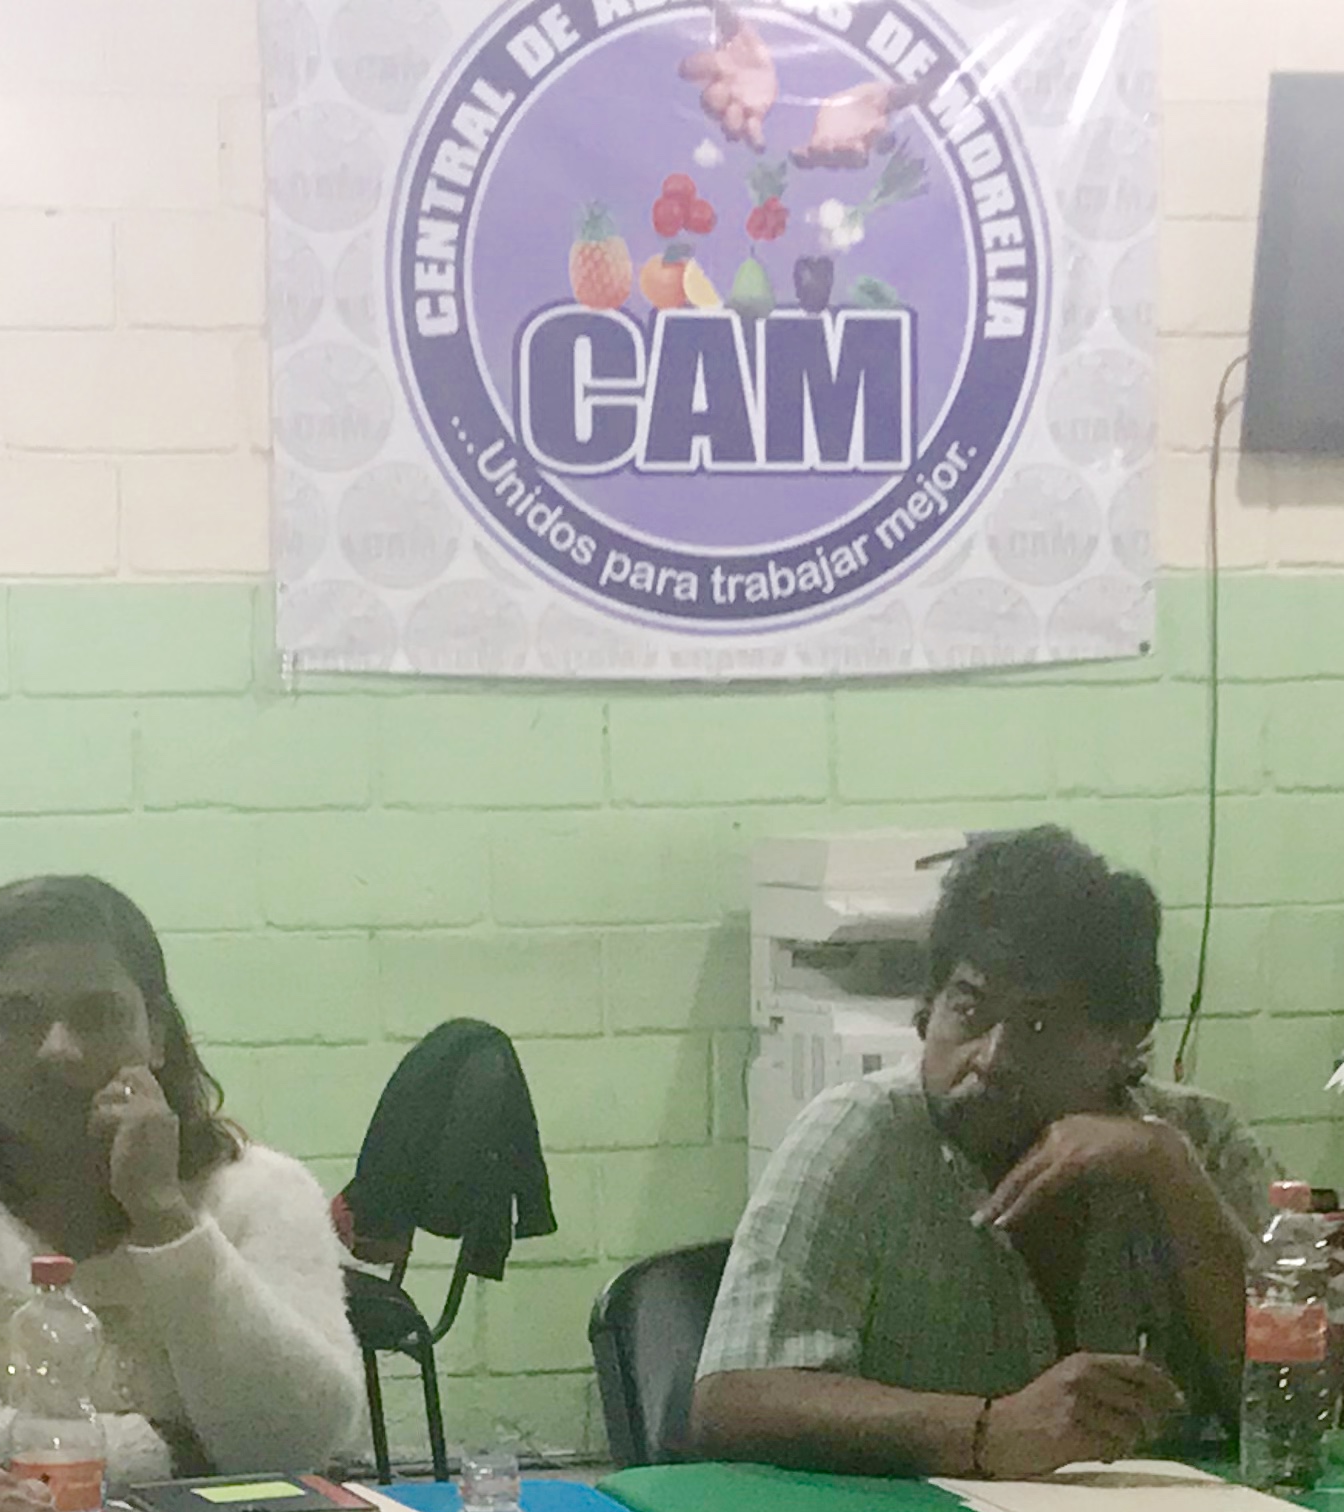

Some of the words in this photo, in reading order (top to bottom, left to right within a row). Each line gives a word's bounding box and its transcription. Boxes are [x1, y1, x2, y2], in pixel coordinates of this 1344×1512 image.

[414, 76, 517, 338] CENTRAL
[506, 2, 581, 79] DE
[865, 10, 939, 85] DE
[928, 73, 1029, 339] MORELIA
[521, 306, 913, 475] CAM
[598, 550, 699, 603] para
[710, 534, 870, 605] trabajar
[874, 440, 978, 550] mejor.
